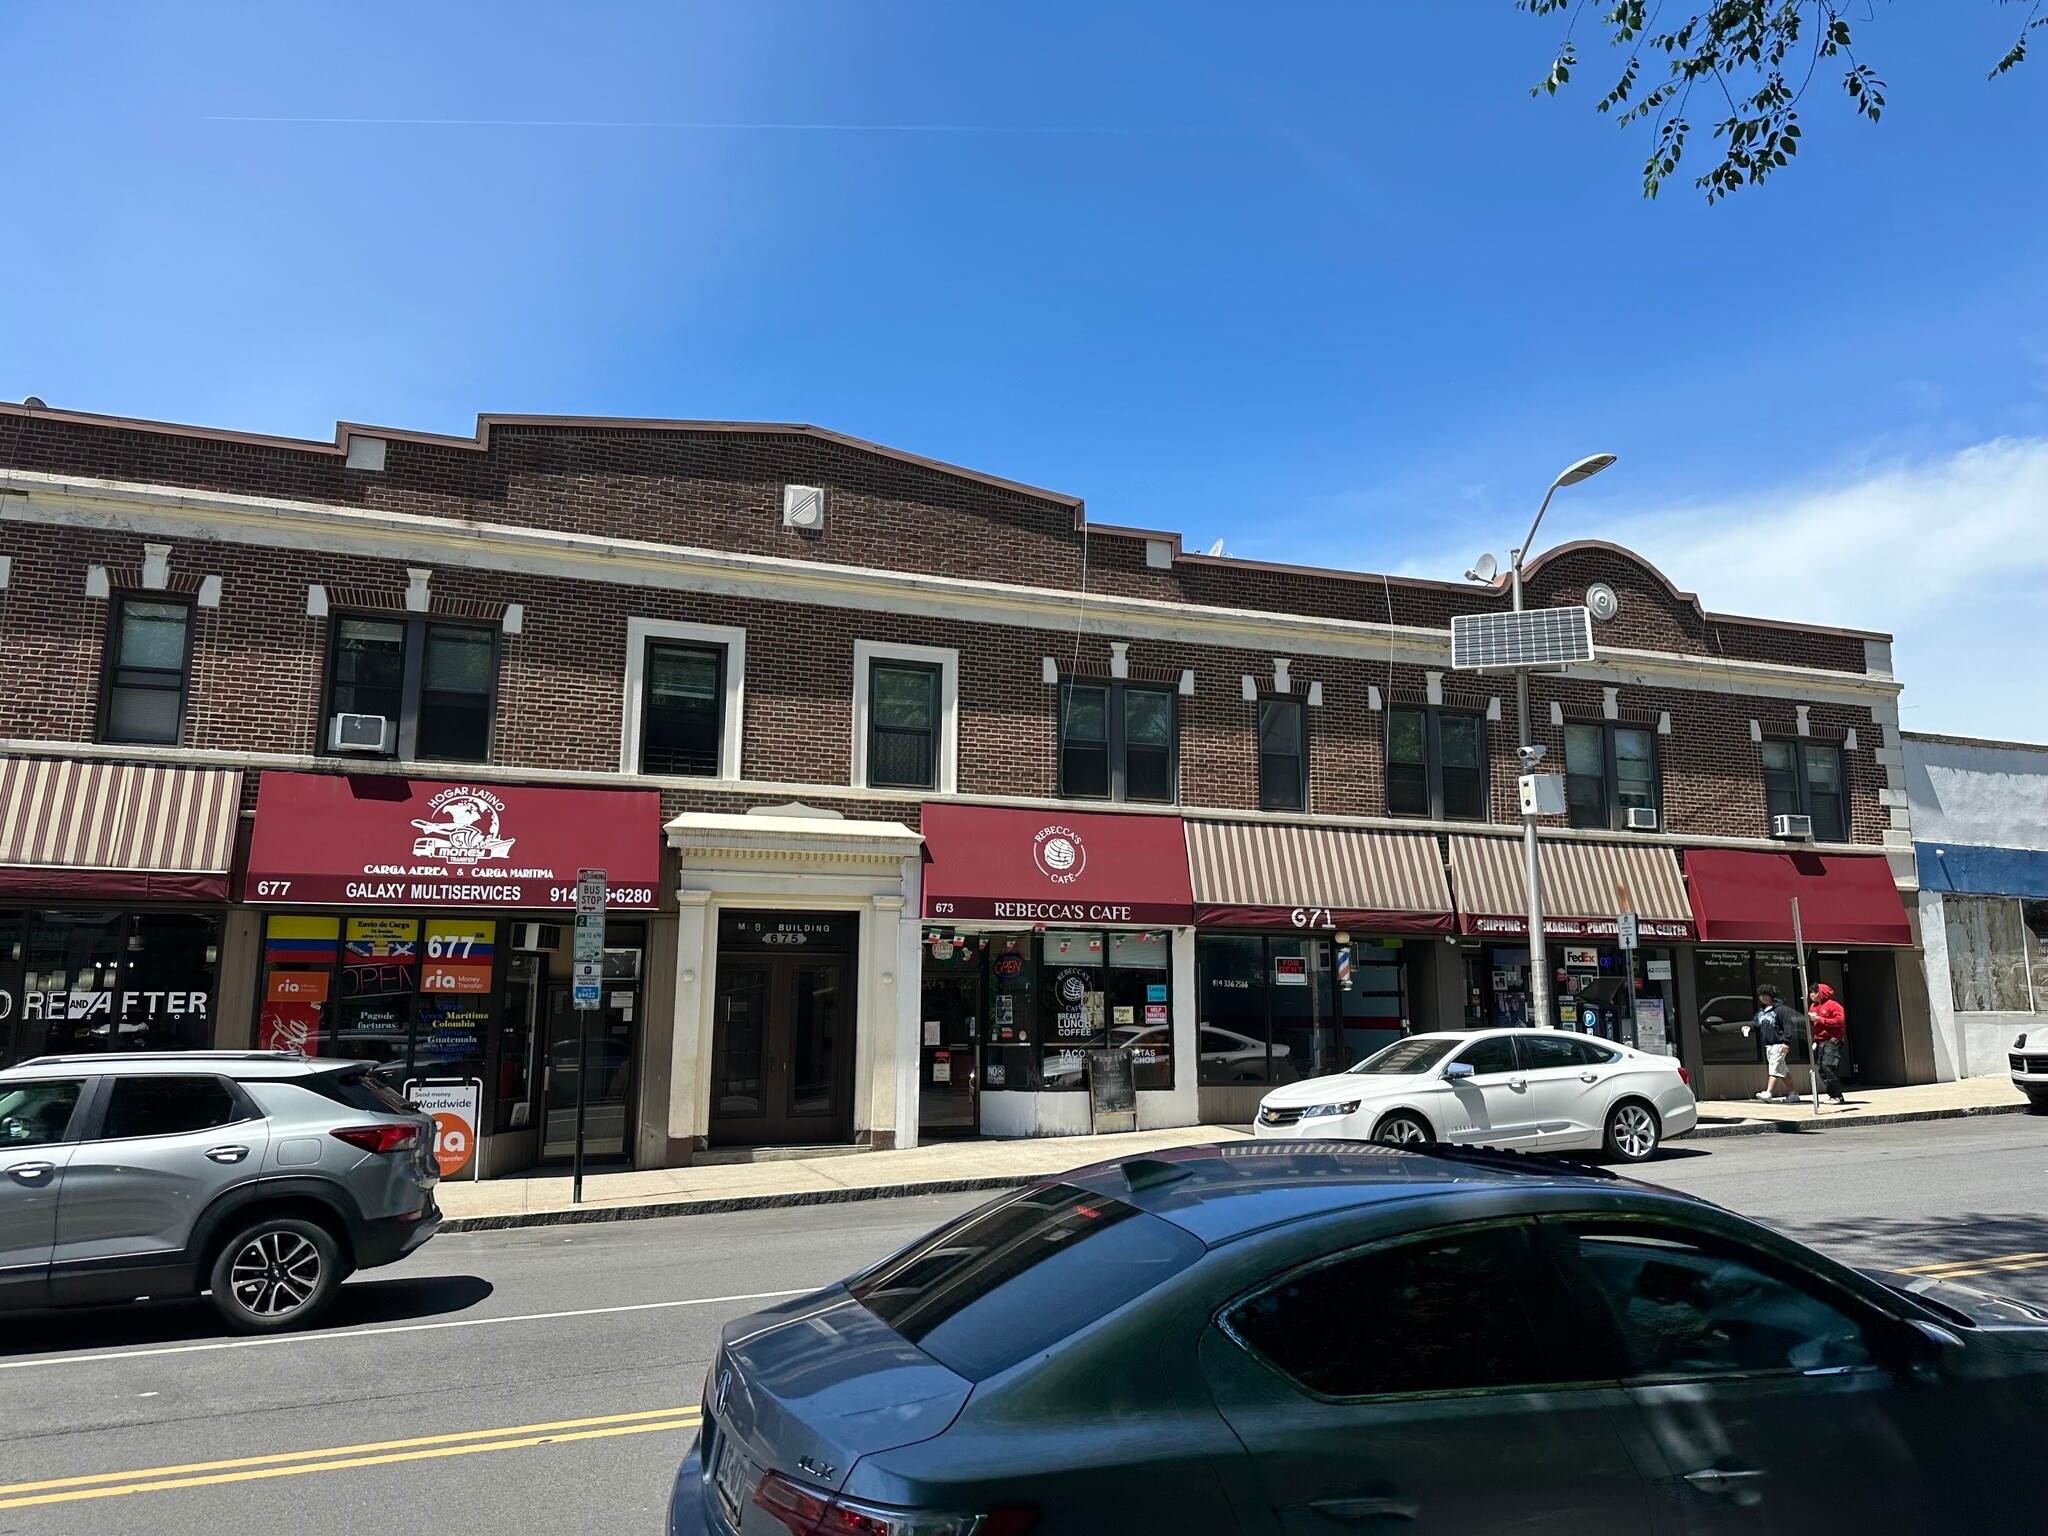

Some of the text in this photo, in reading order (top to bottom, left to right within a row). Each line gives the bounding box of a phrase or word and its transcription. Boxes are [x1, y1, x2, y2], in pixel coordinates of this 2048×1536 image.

[427, 786, 505, 811] HOGAR LATINO
[1034, 826, 1082, 844] REBECCA'S
[364, 864, 406, 875] CARGA
[408, 865, 448, 876] AEREA
[471, 867, 508, 878] CARGA
[510, 868, 554, 878] MARITIMA
[257, 880, 291, 896] 677
[346, 882, 521, 901] GALAXY MULTISERVICES
[584, 885, 600, 895] BUS
[581, 895, 602, 905] STOP
[935, 903, 954, 913] 673
[994, 902, 1131, 921] REBECCA'S CAFE
[389, 921, 410, 929] Carga
[579, 917, 585, 926] 2
[1291, 908, 1336, 928] 671
[778, 923, 830, 932] BUILDING
[1476, 919, 1521, 932] SHIPPING
[1528, 920, 1580, 934] CKAGING
[1655, 923, 1689, 936] CENTER
[770, 934, 799, 943] 675
[427, 935, 475, 959] 677
[1567, 951, 1595, 963] FedEx
[994, 960, 1021, 975] OPEN
[1056, 967, 1091, 981] REBECCA'S
[278, 979, 299, 992] ria
[342, 965, 414, 995] OPEN
[425, 969, 456, 989] ria
[69, 1000, 89, 1009] AND
[89, 991, 207, 1014] AFTER
[357, 1021, 396, 1030] facturas
[432, 1019, 475, 1028] Colombia
[1057, 1020, 1091, 1029] LUNCH
[1059, 1049, 1086, 1058] TACO
[987, 1066, 997, 1076] NO
[420, 1099, 471, 1109] Worldwide
[433, 1121, 465, 1152] ia
[798, 1455, 836, 1481] ILX
